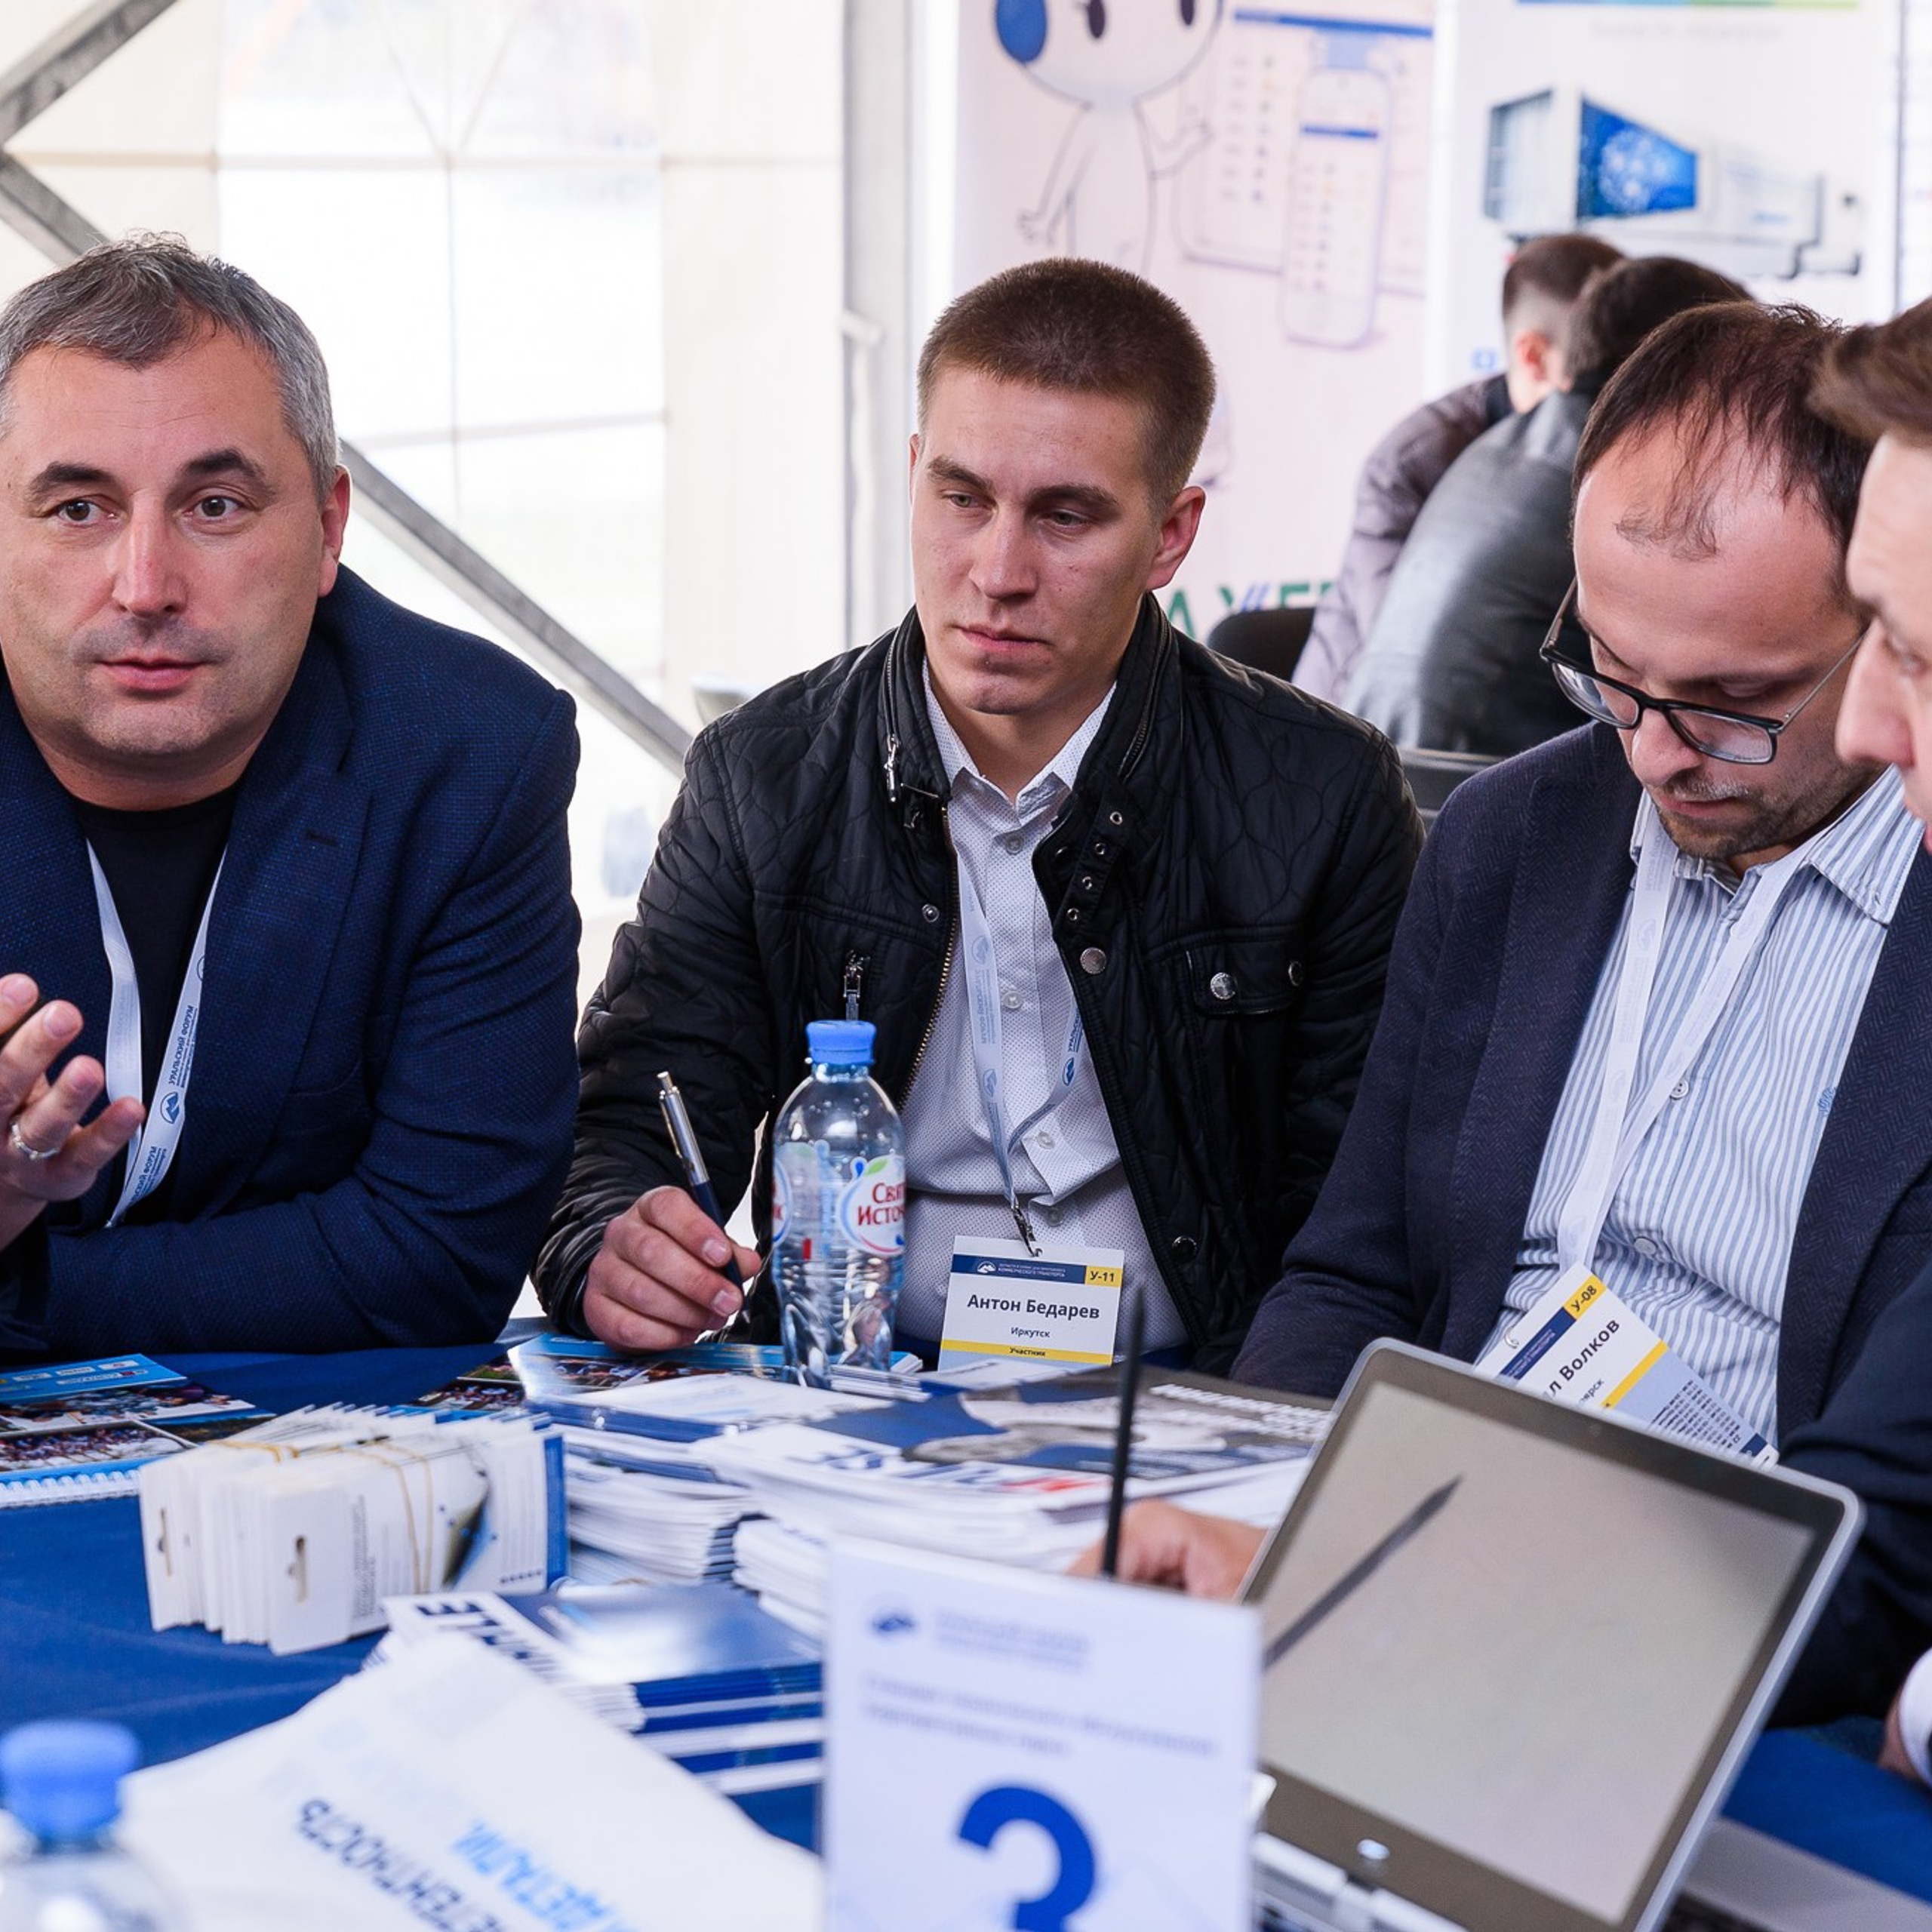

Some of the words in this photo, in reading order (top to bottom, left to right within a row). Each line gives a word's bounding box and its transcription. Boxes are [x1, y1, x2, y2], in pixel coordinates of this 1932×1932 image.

[168, 1036, 186, 1085] УРАЛЬСКИЙ
[181, 1004, 194, 1035] ФОРУМ
[1090, 1271, 1115, 1282] У-11
[967, 1294, 1021, 1312] Антон
[1026, 1300, 1100, 1321] Бедарев
[1571, 1284, 1597, 1312] У-08
[1011, 1327, 1051, 1339] Иркутск
[1009, 1347, 1046, 1357] Участник
[1559, 1319, 1620, 1383] Волков
[957, 1783, 1096, 1932] 3
